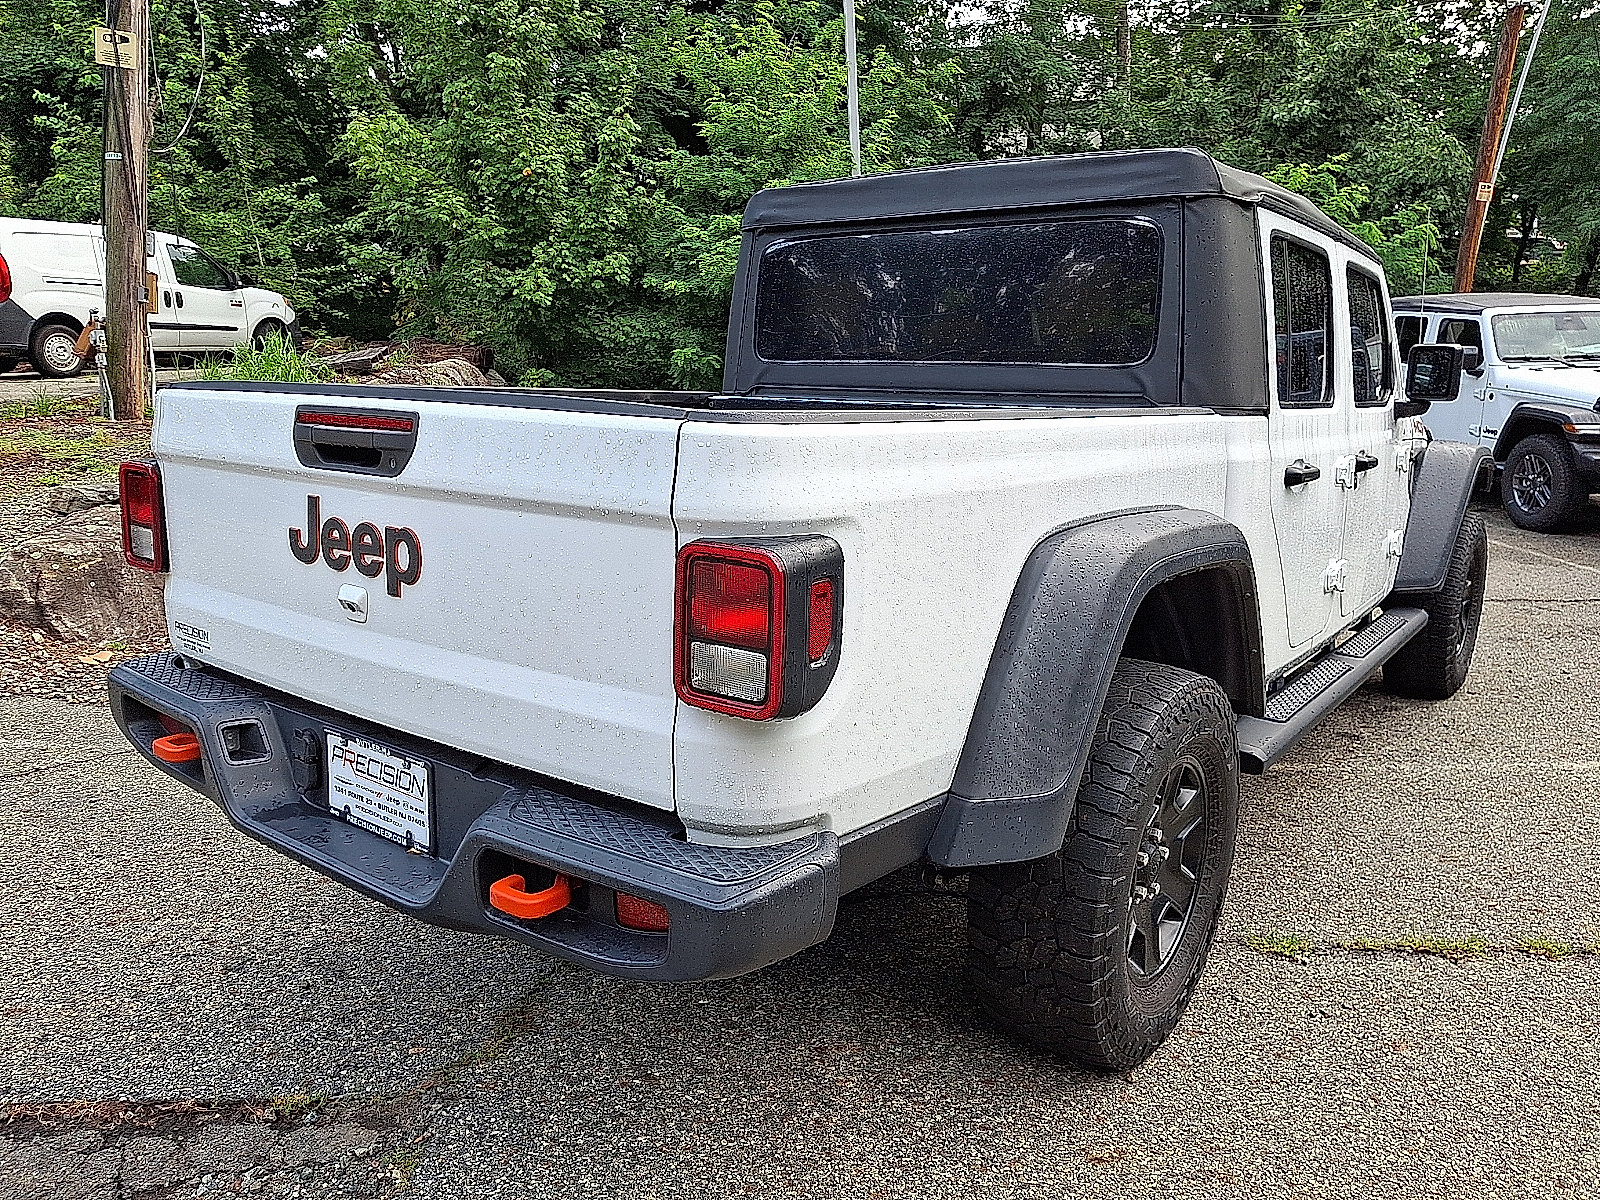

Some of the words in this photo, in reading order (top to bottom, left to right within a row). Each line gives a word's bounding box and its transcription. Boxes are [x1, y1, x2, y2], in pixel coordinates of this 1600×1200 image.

[1482, 425, 1498, 437] Jeep
[288, 494, 422, 599] Jeep
[331, 744, 426, 798] PRECISION
[347, 789, 365, 803] ROUTE
[365, 797, 373, 807] 23
[377, 802, 398, 818] BUTLER
[399, 810, 407, 820] NJ
[407, 813, 426, 828] 07405
